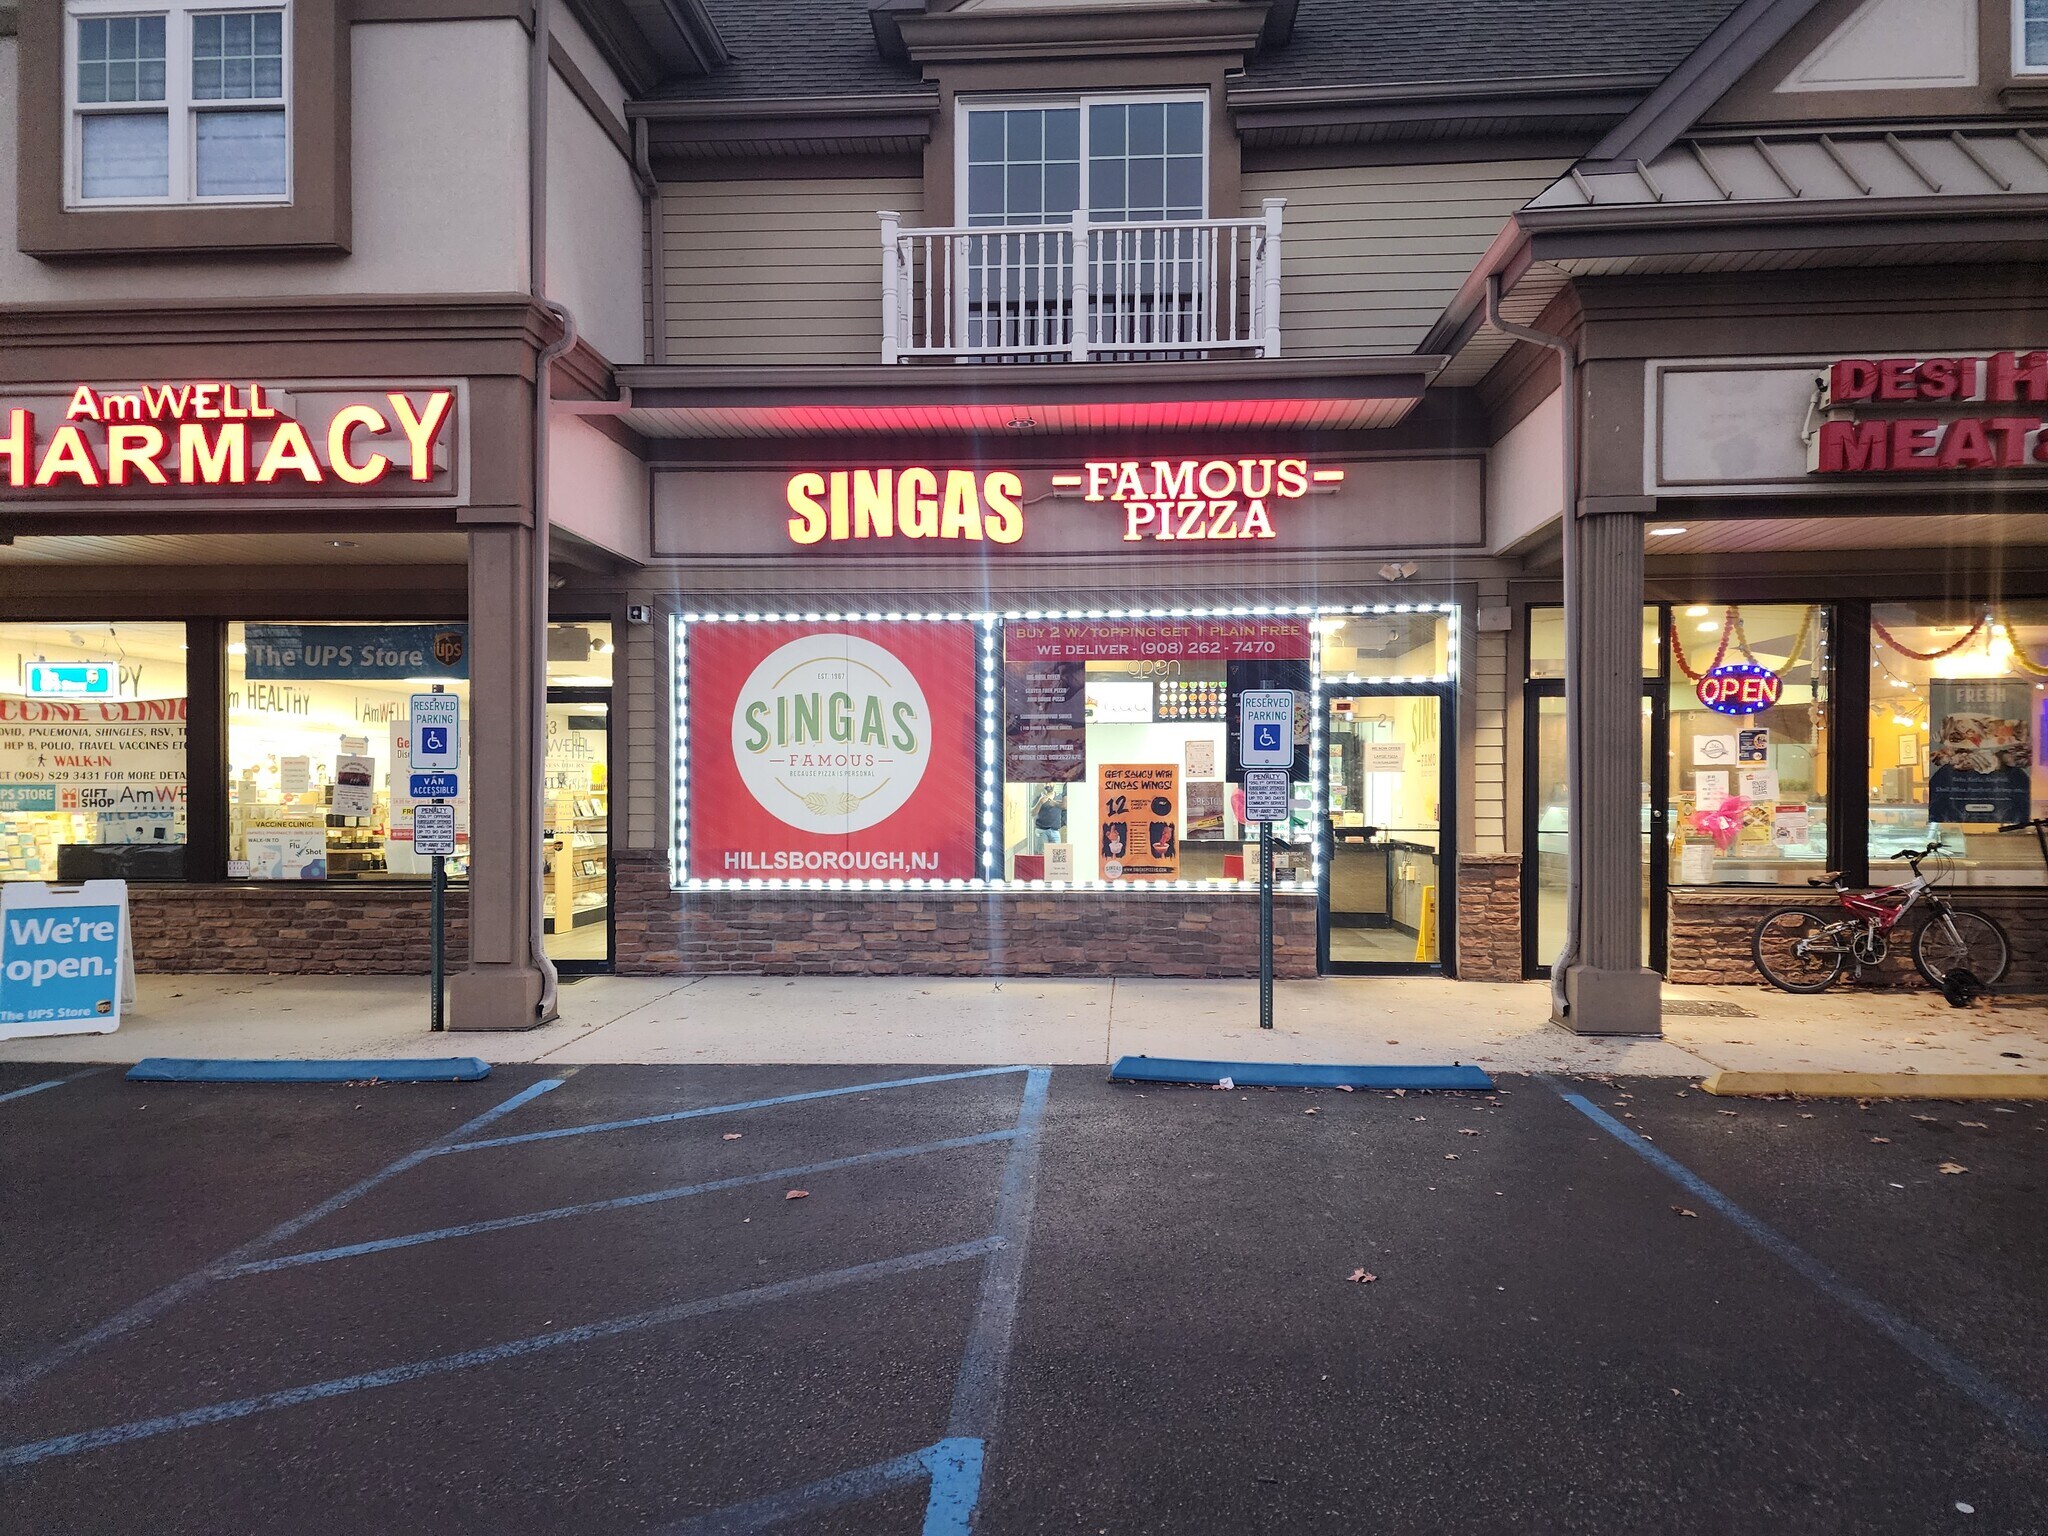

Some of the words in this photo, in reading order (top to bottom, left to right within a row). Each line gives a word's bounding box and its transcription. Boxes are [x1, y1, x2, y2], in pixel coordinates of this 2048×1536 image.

[1831, 357, 1977, 403] DESI
[66, 383, 276, 421] AmWELL
[1084, 459, 1309, 503] FAMOUS
[786, 467, 1025, 545] SINGAS
[1123, 500, 1277, 542] PIZZA
[1016, 628, 1045, 638] BUY
[1050, 627, 1060, 638] 2
[1065, 626, 1157, 638] W/TOPPING
[1160, 626, 1191, 637] GET
[1210, 626, 1256, 637] PLAIN
[1260, 625, 1301, 636] FREE
[435, 641, 463, 664] ups
[1037, 645, 1062, 655] WE
[1065, 644, 1129, 655] DELIVER
[1141, 642, 1183, 655] (908)
[1188, 641, 1221, 654] 262
[1232, 641, 1276, 654] 7470
[251, 645, 296, 667] The
[304, 645, 353, 667] UPS
[360, 645, 423, 667] Store
[1700, 678, 1779, 703] OPEN
[1956, 687, 2006, 703] FRESH
[247, 682, 310, 716] HEALTHY
[413, 701, 456, 711] RESERVED
[1245, 698, 1290, 708] RESERVED
[416, 714, 453, 724] PARKING
[745, 691, 918, 755] SINGAS
[1248, 711, 1287, 721] PARKING
[1377, 713, 1387, 728] 2
[95, 727, 147, 737] SHINGLES,
[150, 727, 174, 737] RSV,
[549, 721, 557, 735] 3
[4, 741, 24, 750] HEP
[41, 741, 74, 751] POLIO,
[79, 741, 115, 750] TRAVEL
[119, 741, 169, 750] VACCINES
[53, 755, 112, 767] WALK-IN
[789, 754, 875, 767] FAMOUS
[14, 771, 44, 782] (908)
[48, 771, 69, 780] 829
[73, 771, 100, 780] 3431
[104, 771, 124, 780] FOR
[128, 771, 156, 780] MORE
[423, 777, 445, 785] VAN
[1104, 770, 1123, 779] GET
[1124, 769, 1153, 779] SAUCY
[18, 789, 54, 800] STORE
[82, 788, 107, 798] GIFT
[413, 786, 455, 795] ACCESSIBLE
[82, 798, 115, 808] SHOP
[1105, 795, 1129, 817] 12
[10, 916, 115, 946] We're
[6, 956, 113, 987] open.
[0, 1011, 25, 1021] The
[27, 1008, 54, 1020] UPS
[57, 1007, 91, 1018] Store
